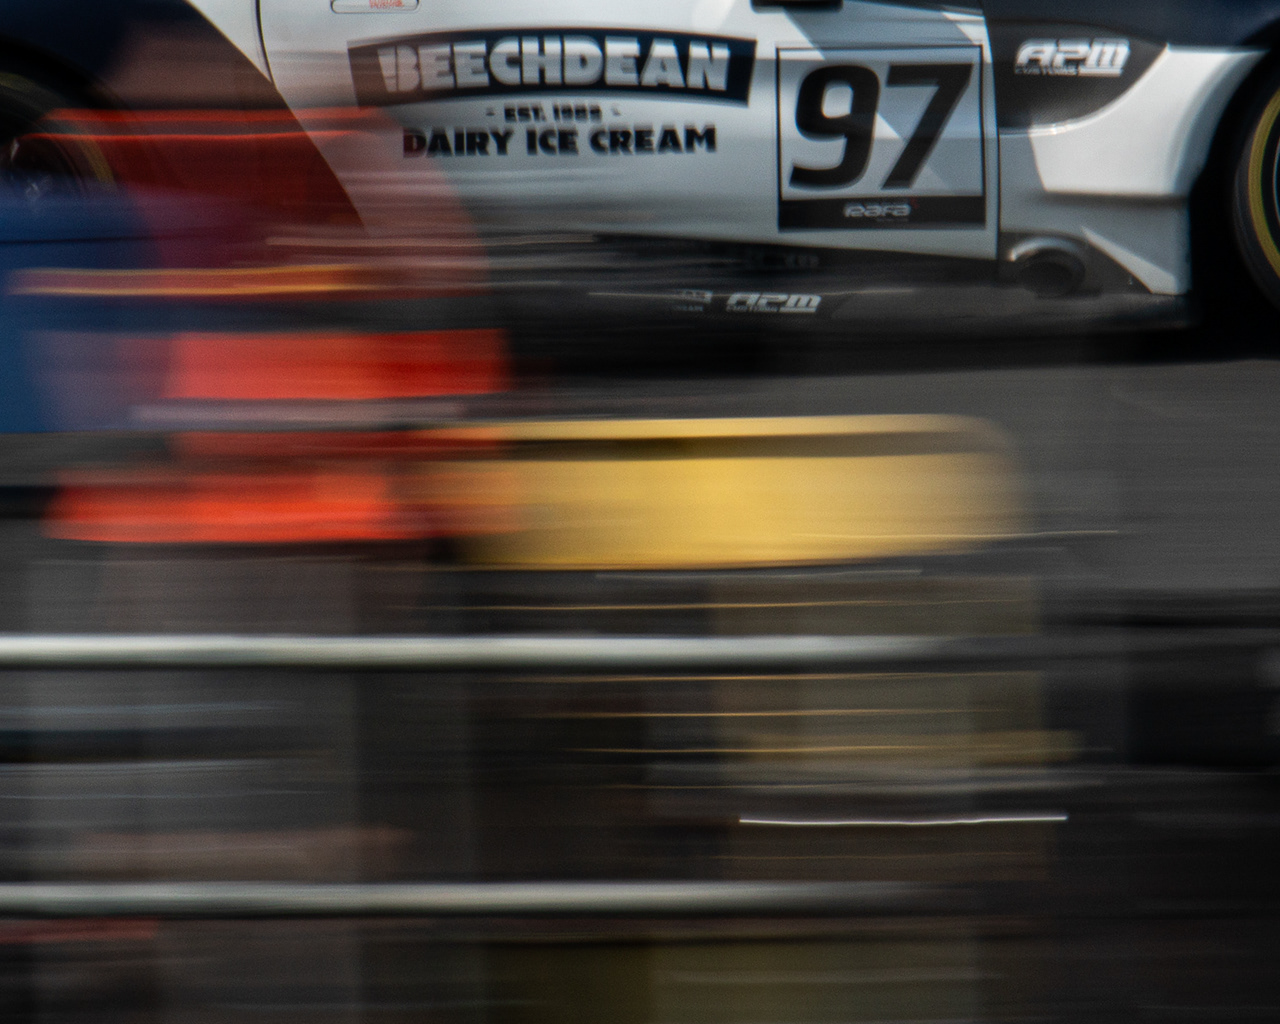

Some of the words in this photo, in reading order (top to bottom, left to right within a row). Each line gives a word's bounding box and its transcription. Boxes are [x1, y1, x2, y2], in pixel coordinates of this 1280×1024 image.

[376, 33, 731, 93] BEECHDEAN
[402, 126, 514, 159] DAIRY
[526, 127, 579, 156] ICE
[590, 124, 717, 154] CREAM
[788, 63, 975, 192] 97
